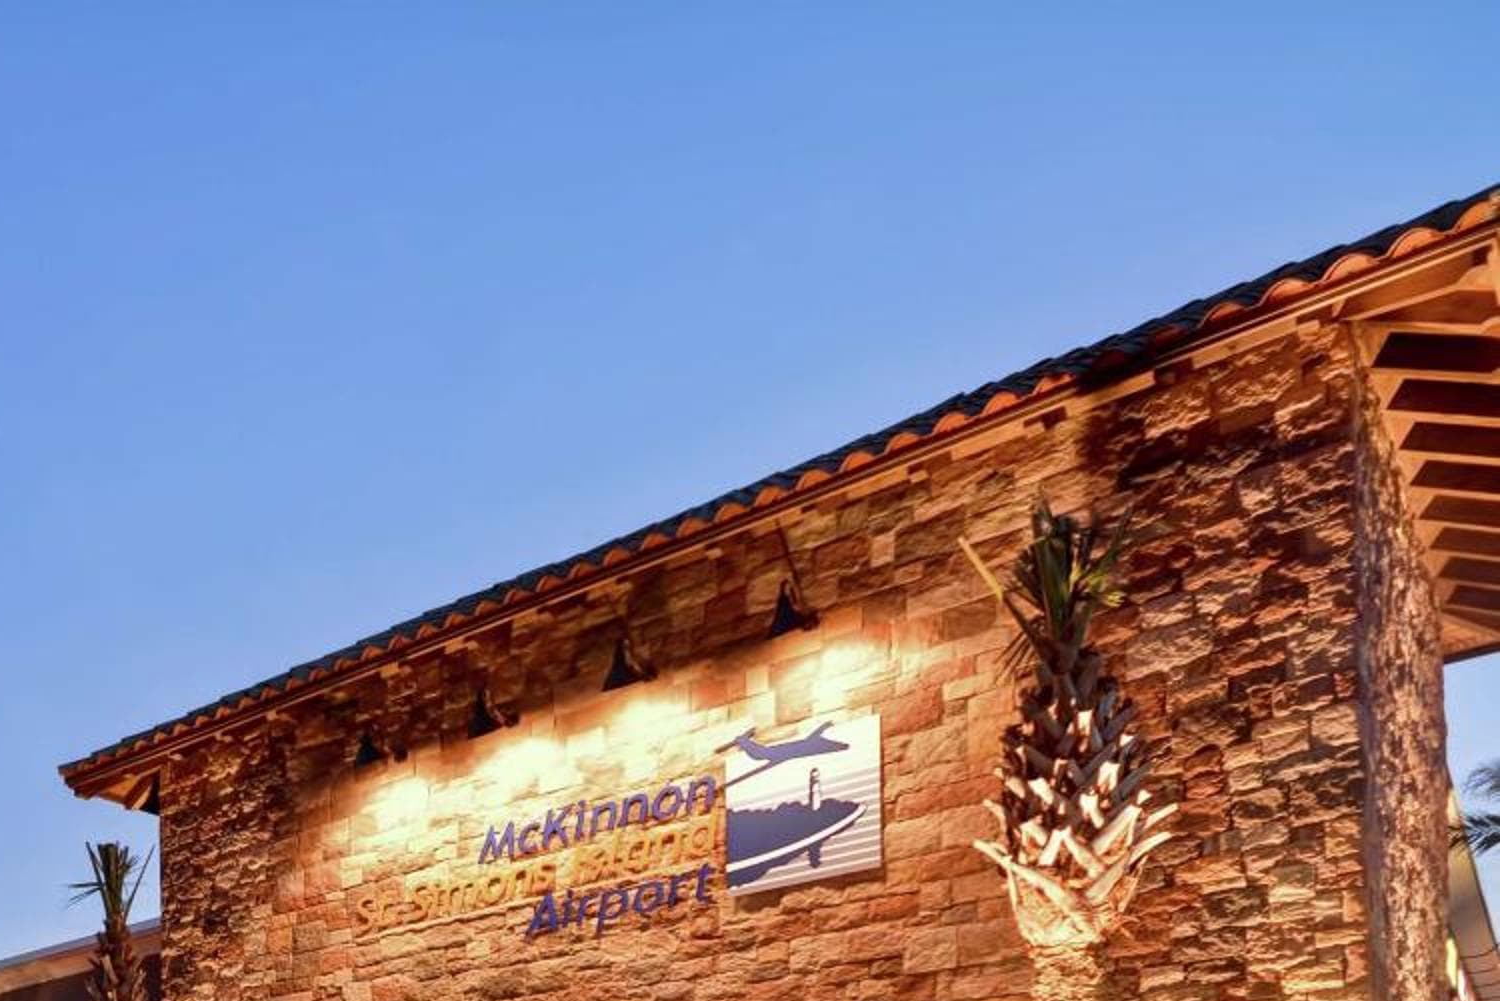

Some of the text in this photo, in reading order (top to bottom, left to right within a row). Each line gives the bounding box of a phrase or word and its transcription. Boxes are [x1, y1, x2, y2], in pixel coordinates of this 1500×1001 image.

[478, 775, 716, 865] McKinnon
[407, 862, 558, 925] Simons
[571, 806, 717, 885] Island
[524, 863, 715, 943] Airport
